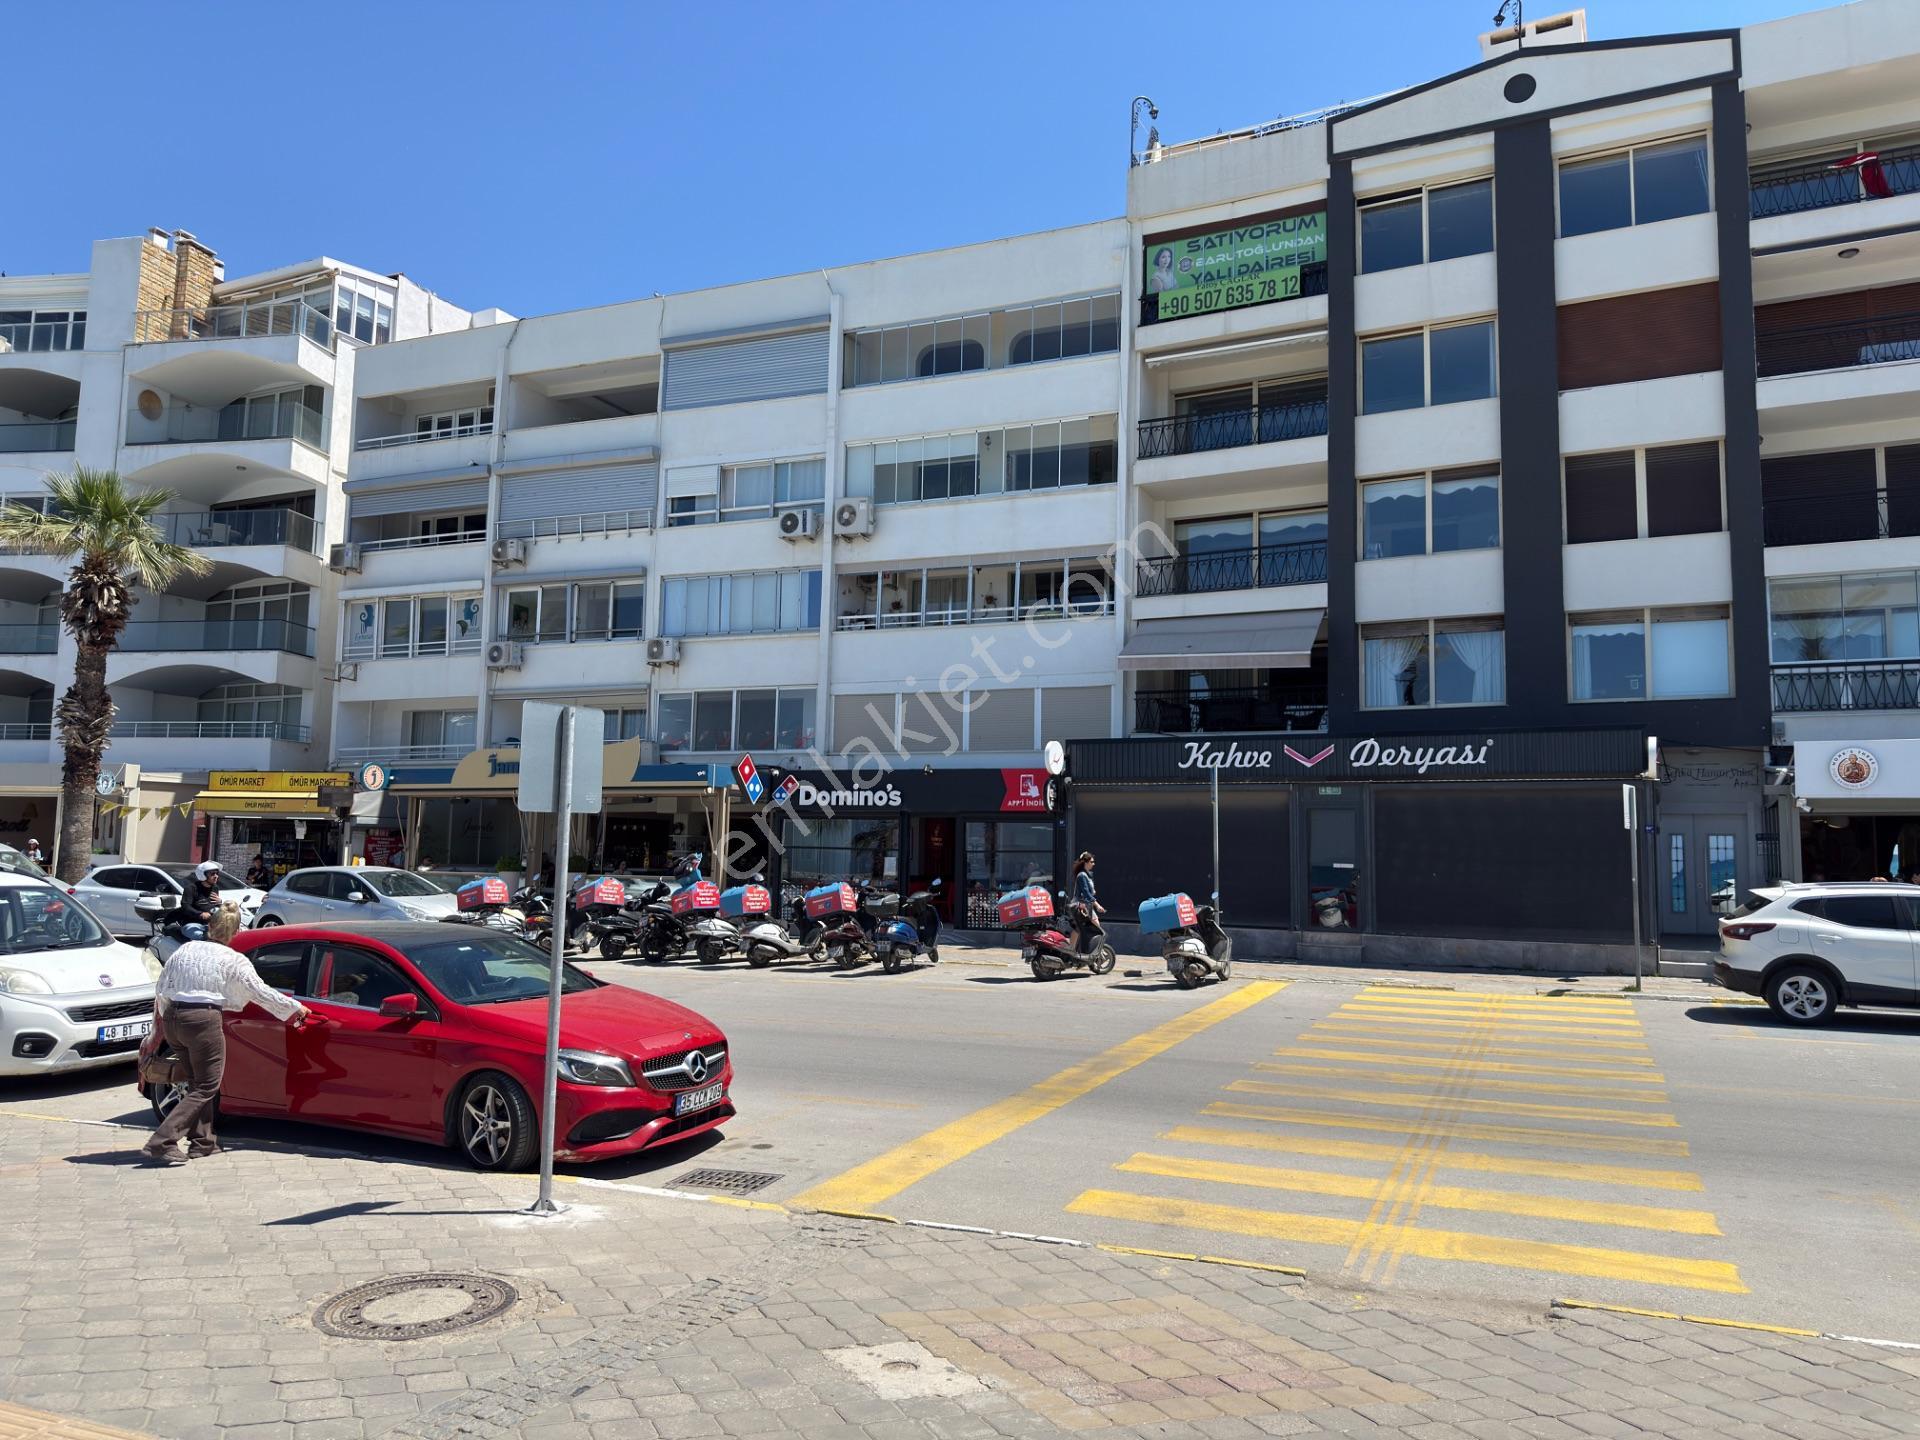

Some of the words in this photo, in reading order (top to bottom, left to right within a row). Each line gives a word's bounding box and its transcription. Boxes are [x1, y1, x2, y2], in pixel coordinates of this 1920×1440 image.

[1187, 215, 1318, 253] SATIYORUM
[1190, 267, 1232, 284] YALI
[1237, 247, 1316, 276] DAİRESİ
[1160, 295, 1189, 315] +90
[1194, 289, 1222, 311] 507
[1226, 284, 1254, 305] 635
[1259, 281, 1276, 299] 78
[1281, 276, 1299, 295] 12
[1177, 741, 1274, 770] Kahve
[219, 777, 238, 787] ÖMÜR
[239, 777, 265, 787] MARKET
[289, 776, 308, 787] ÖMÜR
[244, 801, 257, 809] ÖMÜR
[257, 801, 276, 809] MARKET
[798, 782, 902, 808] Domino's
[105, 1027, 117, 1039] 48
[122, 1025, 133, 1037] BT
[681, 1094, 693, 1109] 35
[708, 1084, 722, 1101] 209
